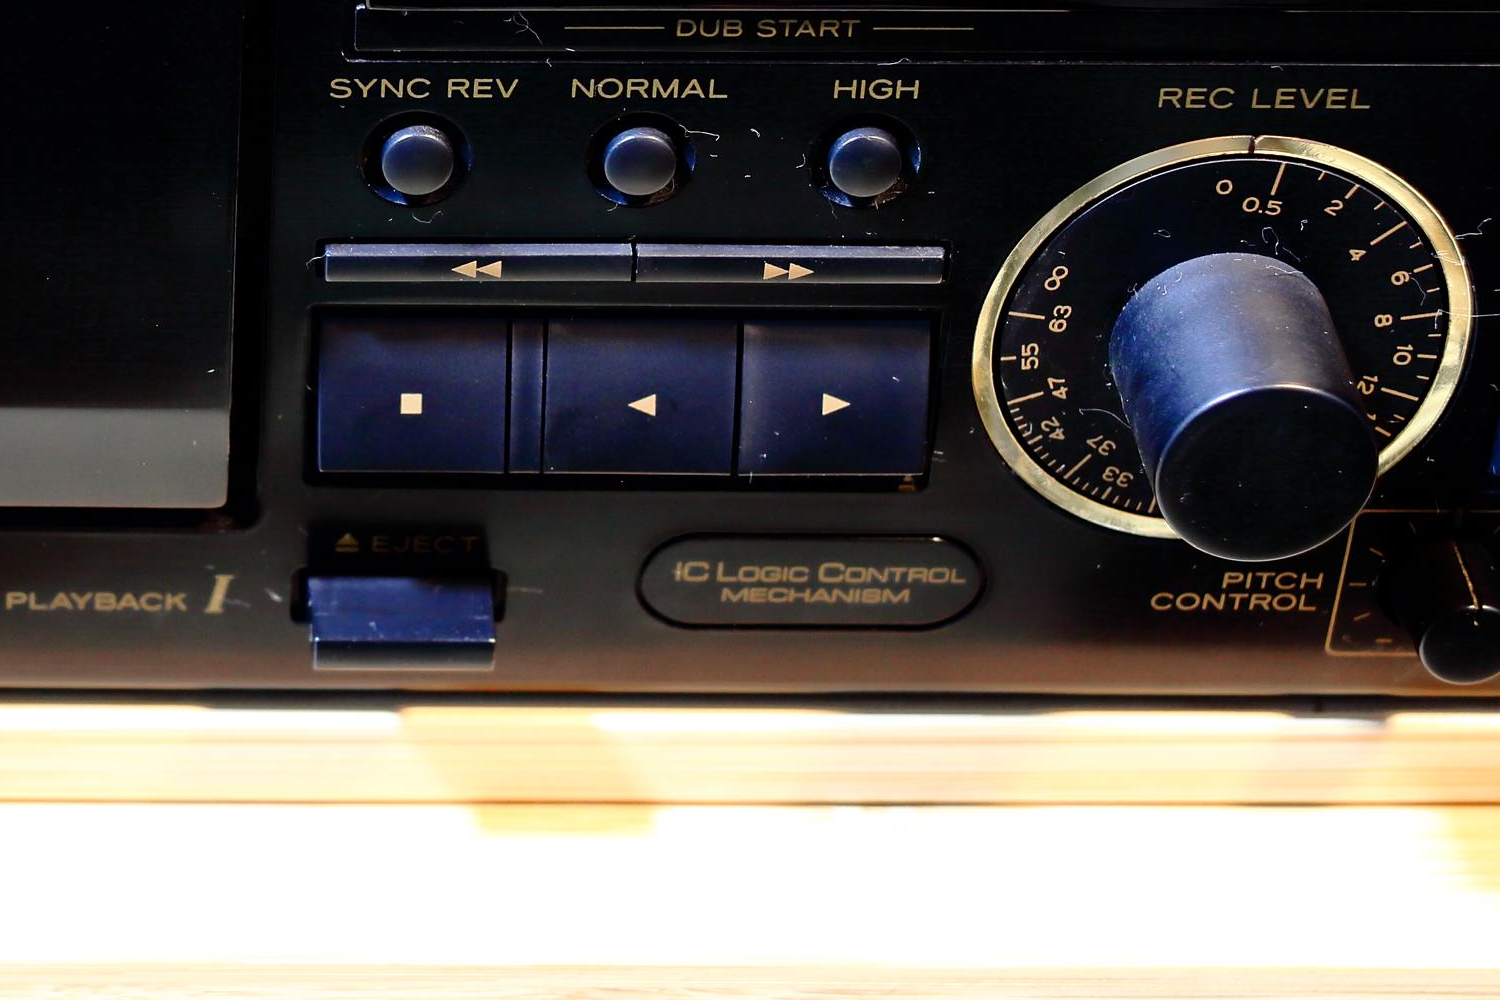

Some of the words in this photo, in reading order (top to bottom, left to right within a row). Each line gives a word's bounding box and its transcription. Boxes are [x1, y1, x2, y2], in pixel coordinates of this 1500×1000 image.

[676, 19, 743, 38] DUB
[756, 19, 861, 38] START
[329, 77, 431, 99] SYNC
[447, 78, 519, 99] REV
[571, 77, 728, 99] NORMAL
[833, 78, 920, 100] HIGH
[1158, 87, 1235, 109] REC
[1251, 87, 1371, 110] LEVEL
[1215, 179, 1233, 195] 0
[1242, 196, 1283, 216] 0.5
[1323, 199, 1344, 217] 2
[1348, 248, 1367, 262] 4
[1390, 270, 1409, 286] 6
[1048, 304, 1072, 333] 63
[1374, 313, 1393, 328] 8
[1020, 342, 1040, 371] 55
[1392, 344, 1414, 366] 10
[1047, 377, 1069, 400] 47
[1356, 375, 1379, 396] 12
[1040, 416, 1066, 440] 42
[1085, 434, 1117, 456] 37
[1101, 466, 1134, 488] 33
[371, 535, 480, 553] EJECT
[674, 561, 710, 583] IC
[1221, 571, 1324, 590] PITCH
[5, 591, 188, 613] PLAYBACK
[720, 587, 911, 605] MECHANISM
[1150, 592, 1317, 612] CONTROL
